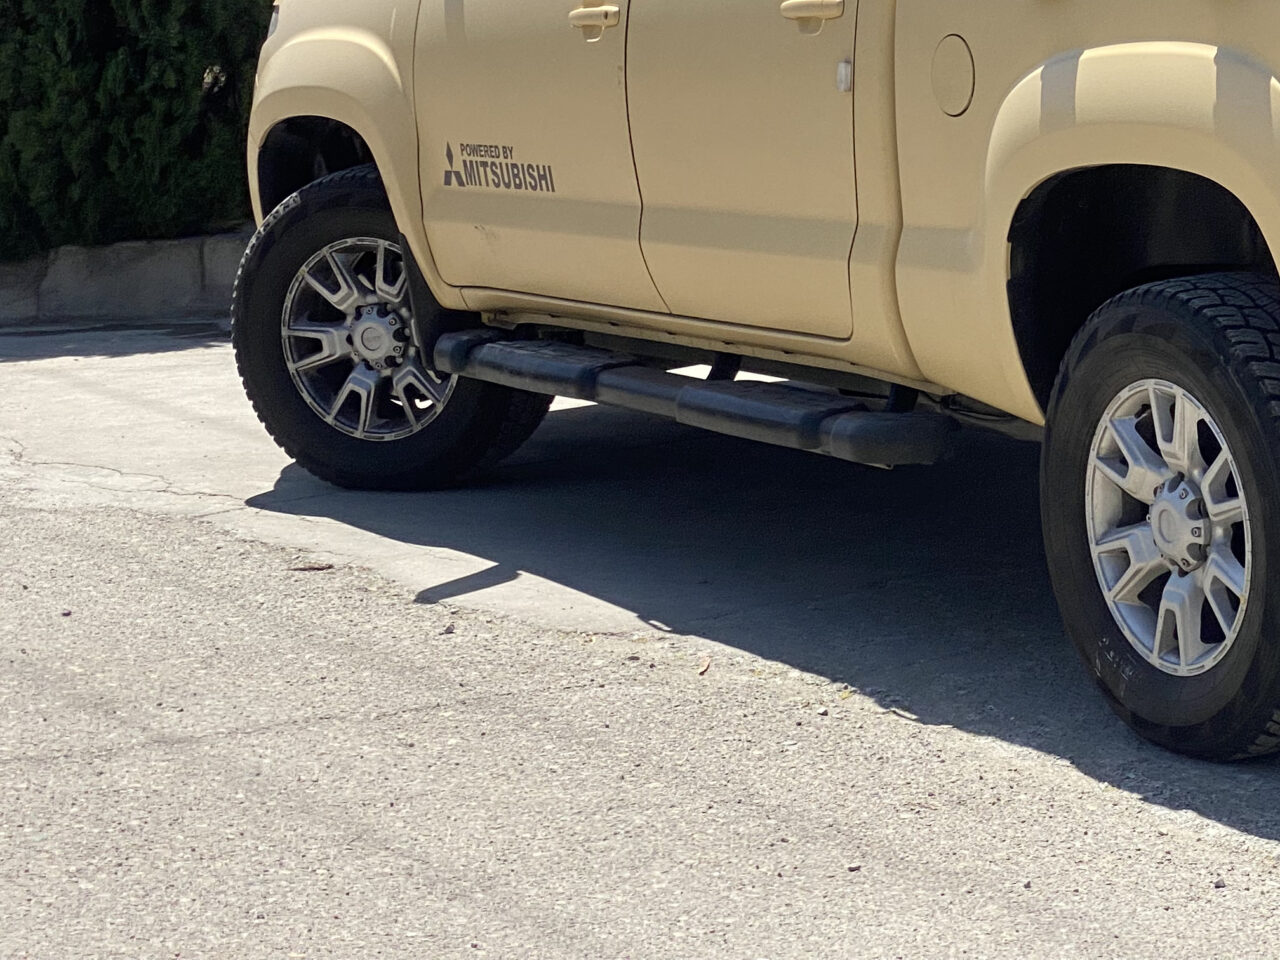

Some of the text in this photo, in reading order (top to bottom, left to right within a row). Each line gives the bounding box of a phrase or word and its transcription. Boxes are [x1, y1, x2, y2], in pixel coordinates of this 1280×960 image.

[460, 143, 514, 160] POWERED BY
[462, 159, 556, 193] MITSUBISHI
